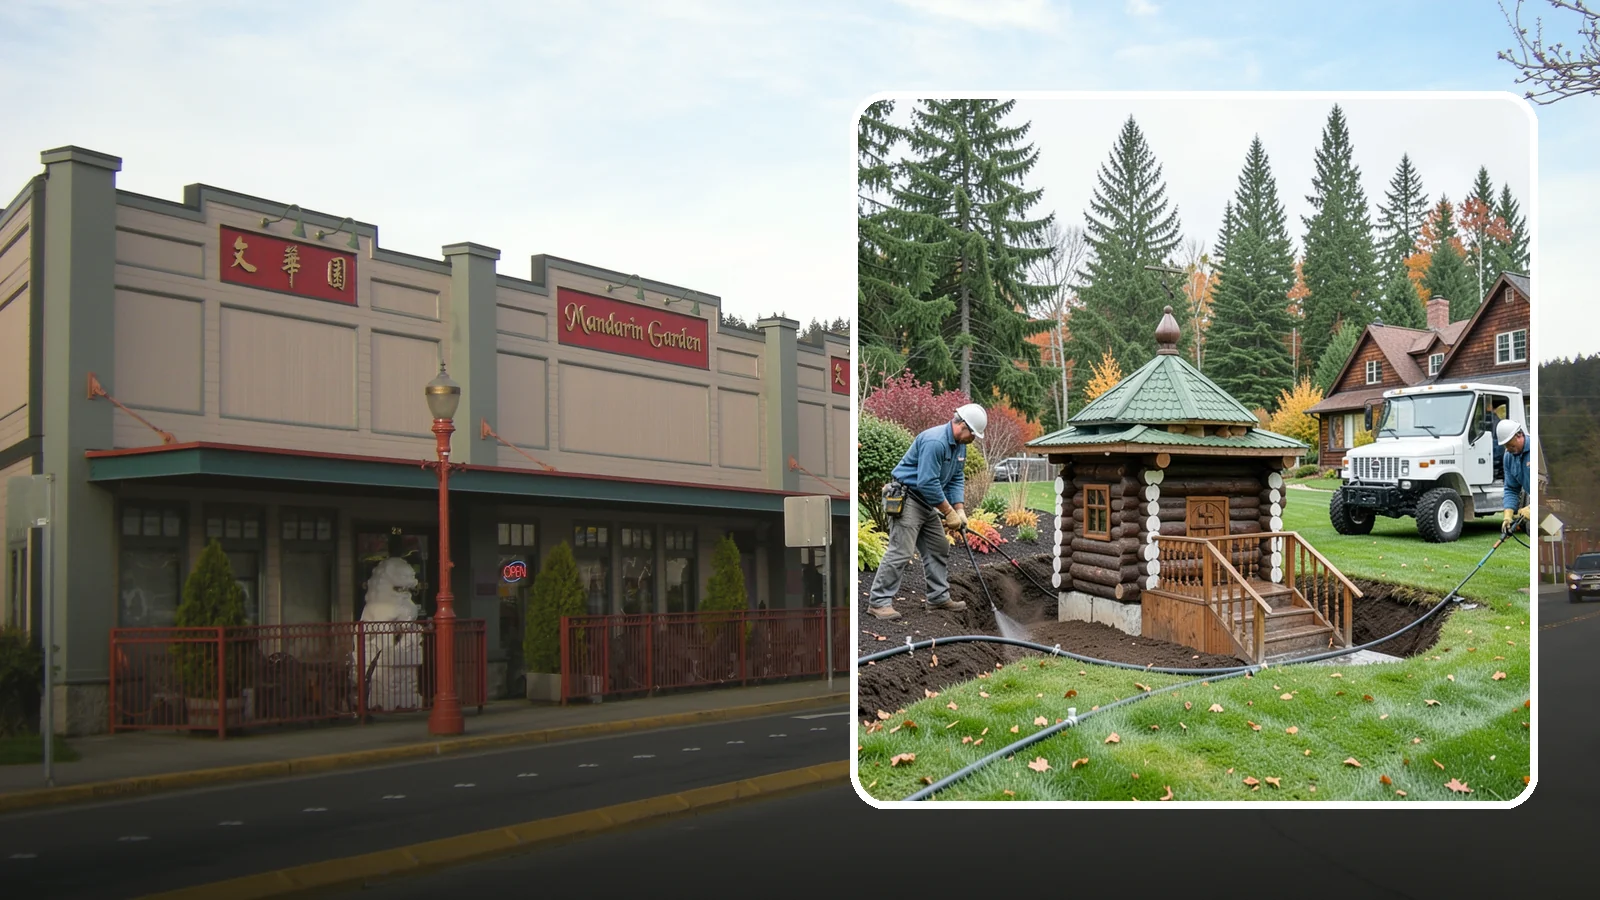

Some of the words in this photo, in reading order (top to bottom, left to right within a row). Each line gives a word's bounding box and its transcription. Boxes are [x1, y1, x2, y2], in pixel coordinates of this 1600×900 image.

[231, 235, 346, 291] 文華園
[564, 302, 644, 341] Mandarin
[648, 320, 701, 352] Garden
[503, 565, 527, 578] OPEN
